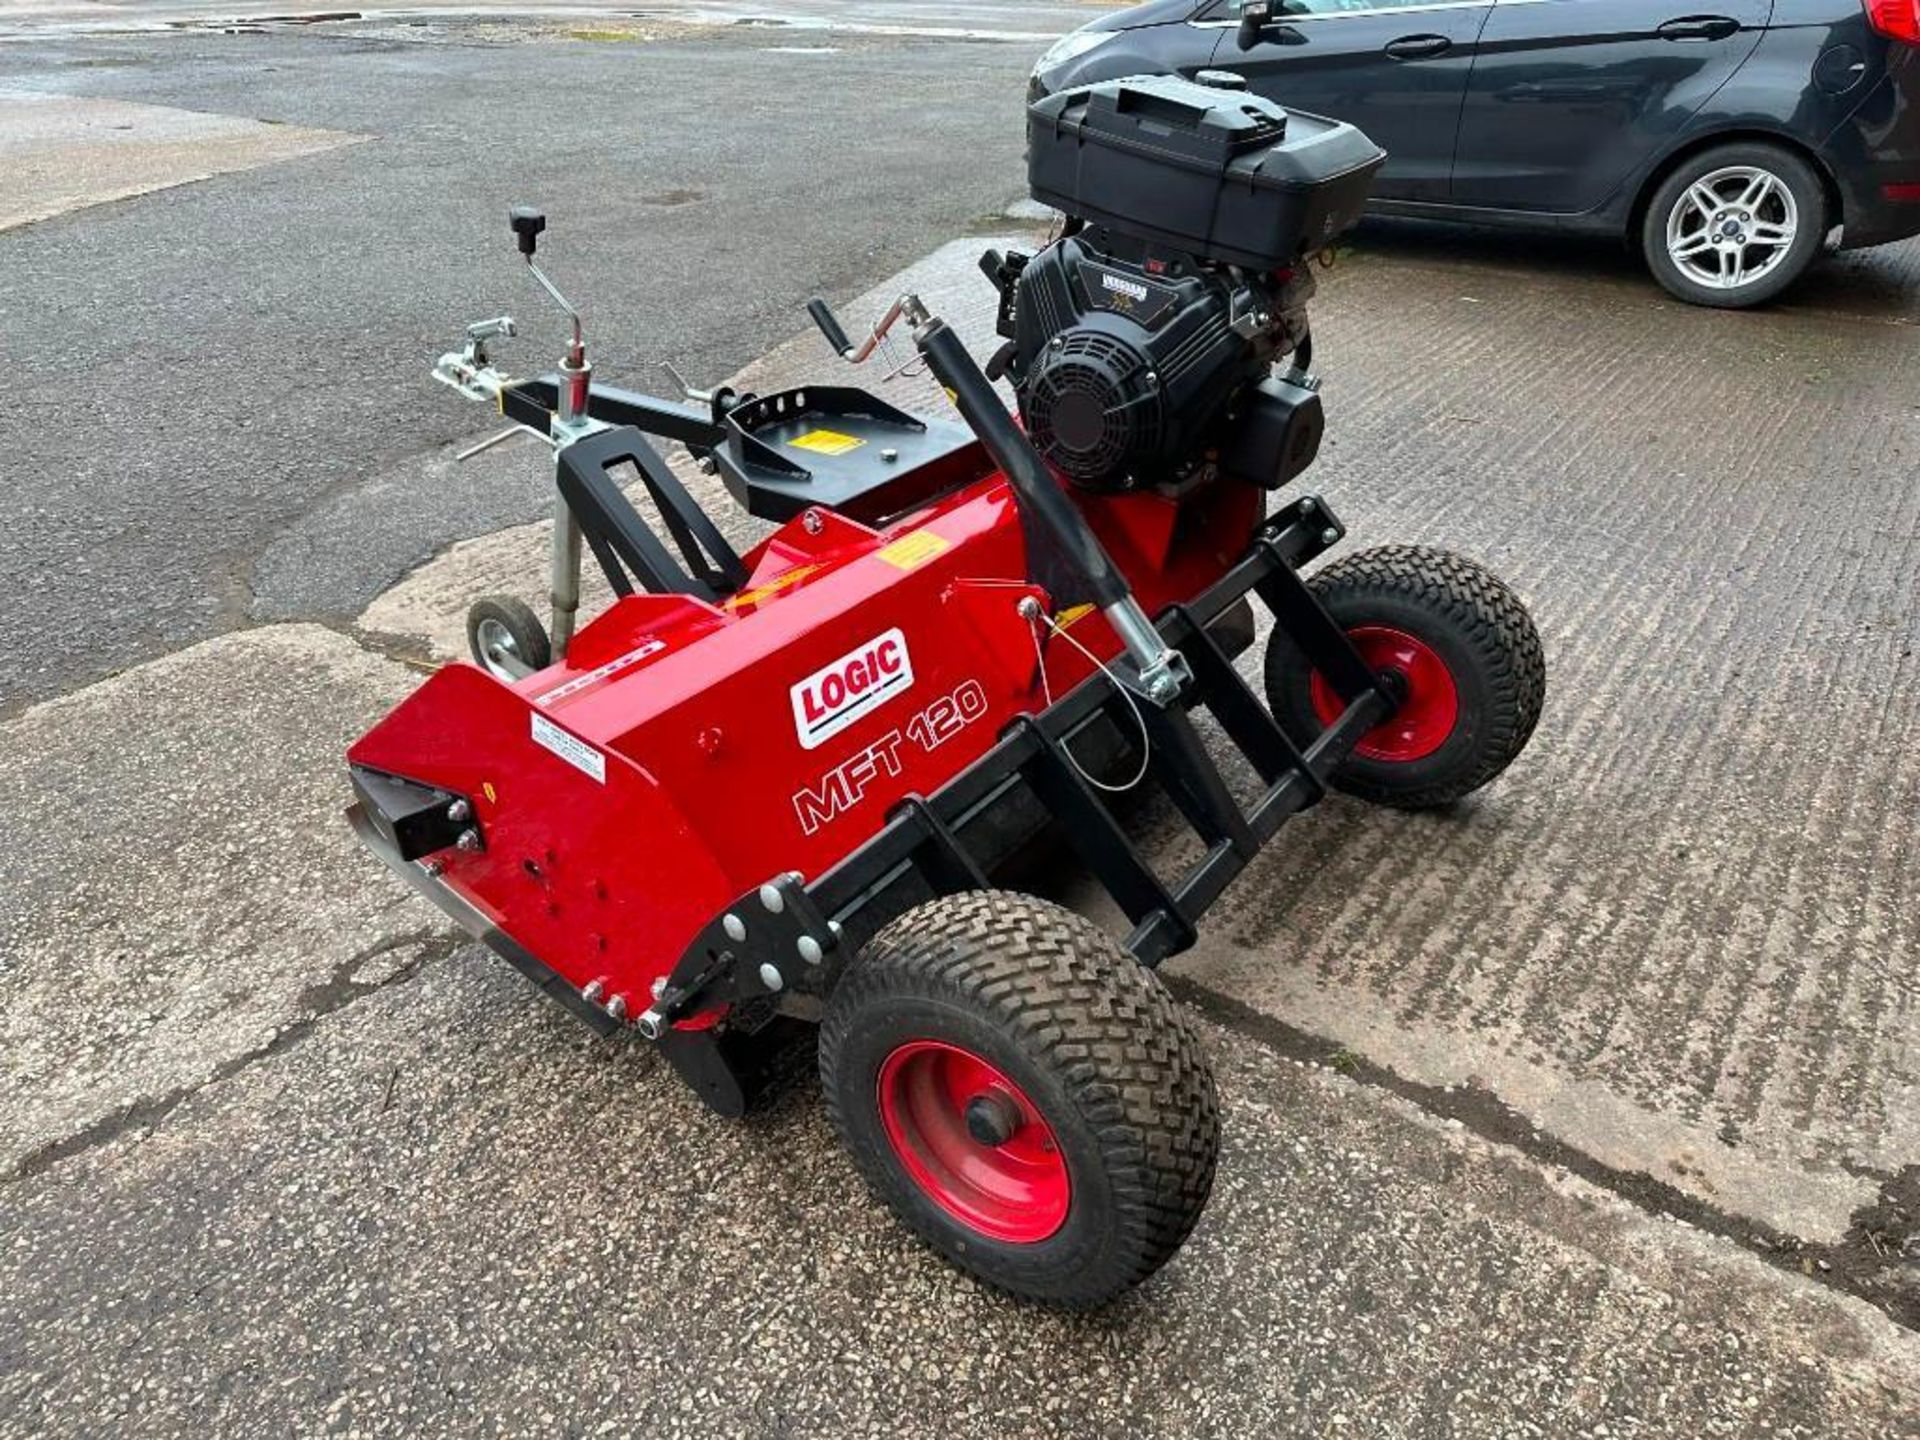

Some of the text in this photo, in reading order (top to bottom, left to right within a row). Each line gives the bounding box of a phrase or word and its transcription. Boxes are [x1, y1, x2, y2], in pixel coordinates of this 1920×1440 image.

[801, 640, 901, 724] LOGIC
[792, 679, 988, 836] MFT 120
